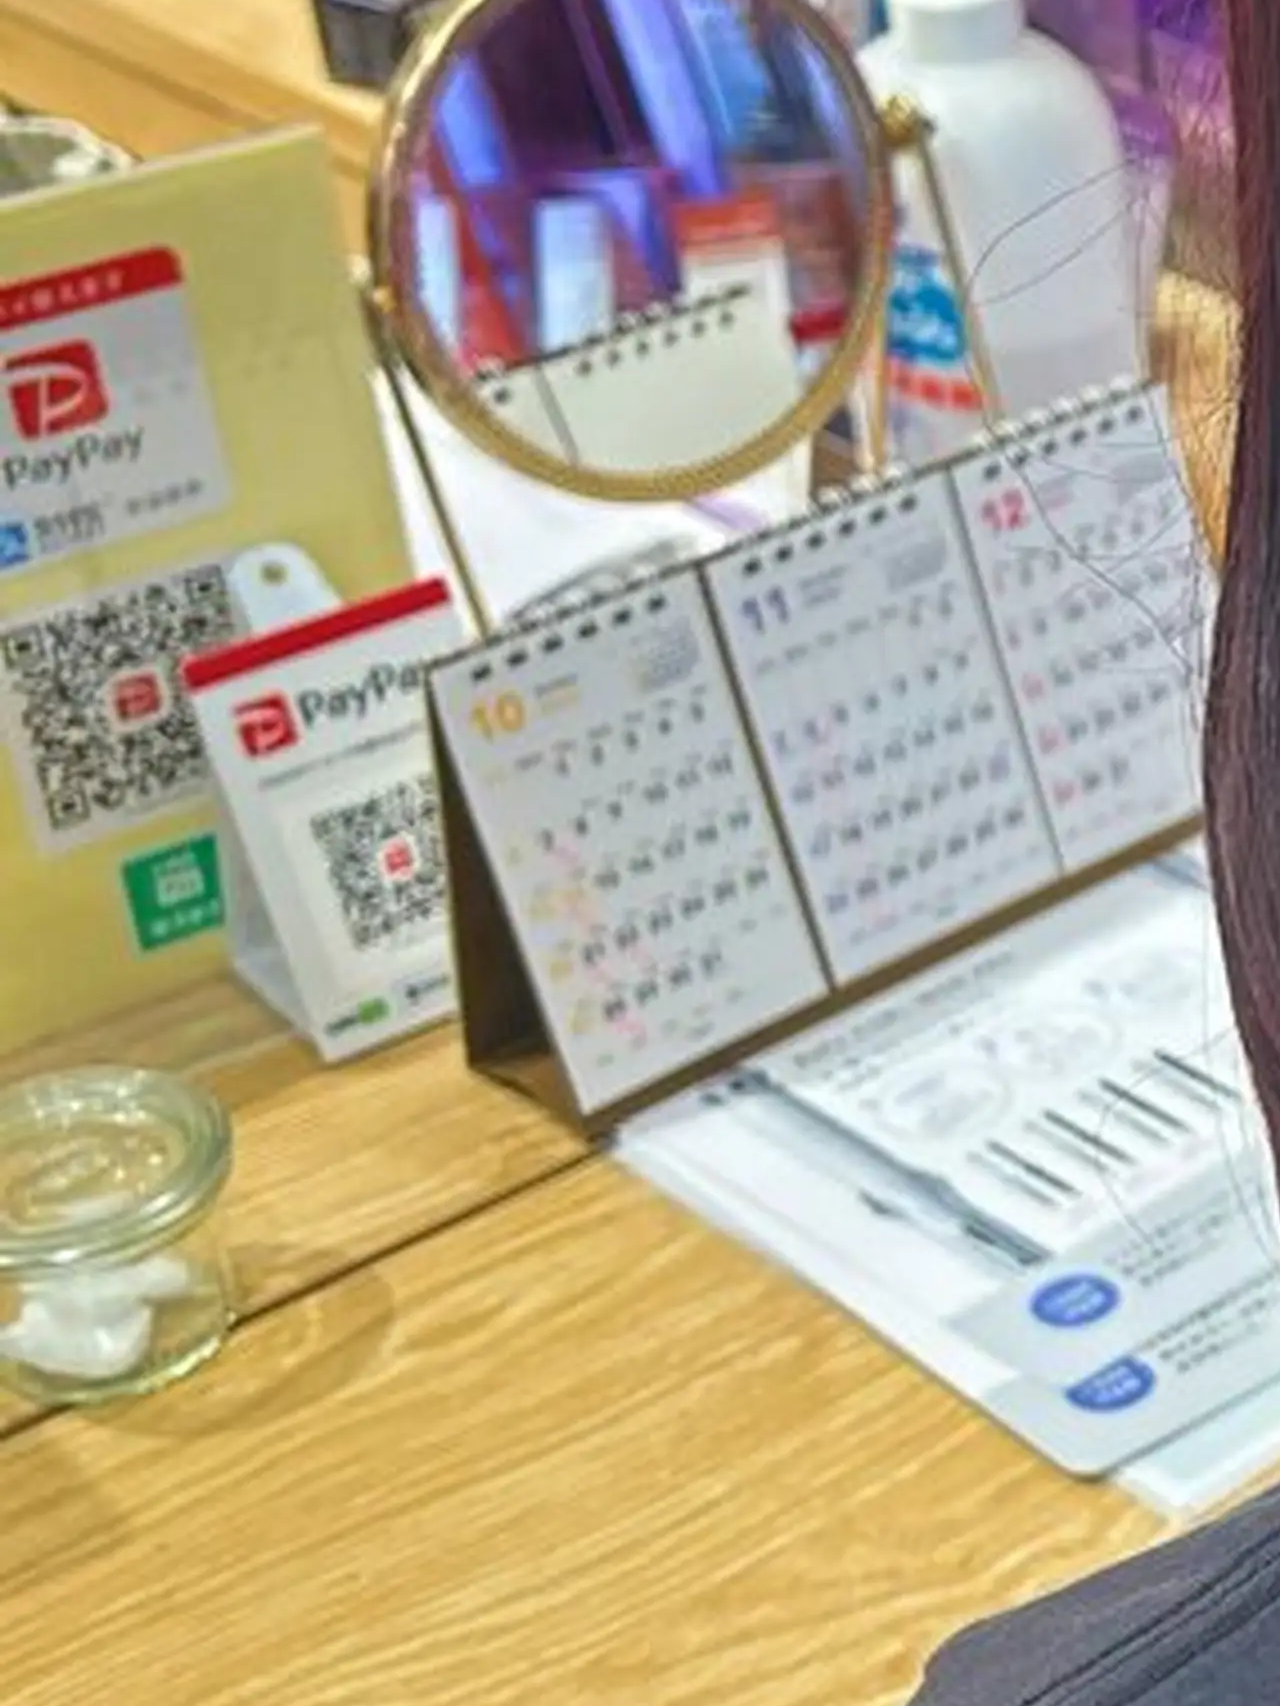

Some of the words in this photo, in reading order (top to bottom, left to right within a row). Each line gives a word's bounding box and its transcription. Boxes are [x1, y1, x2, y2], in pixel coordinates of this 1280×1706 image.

[2, 424, 145, 491] PayPay
[980, 486, 1028, 535] 12
[741, 585, 790, 634] 11
[297, 663, 426, 729] PayPa
[468, 690, 526, 745] 10
